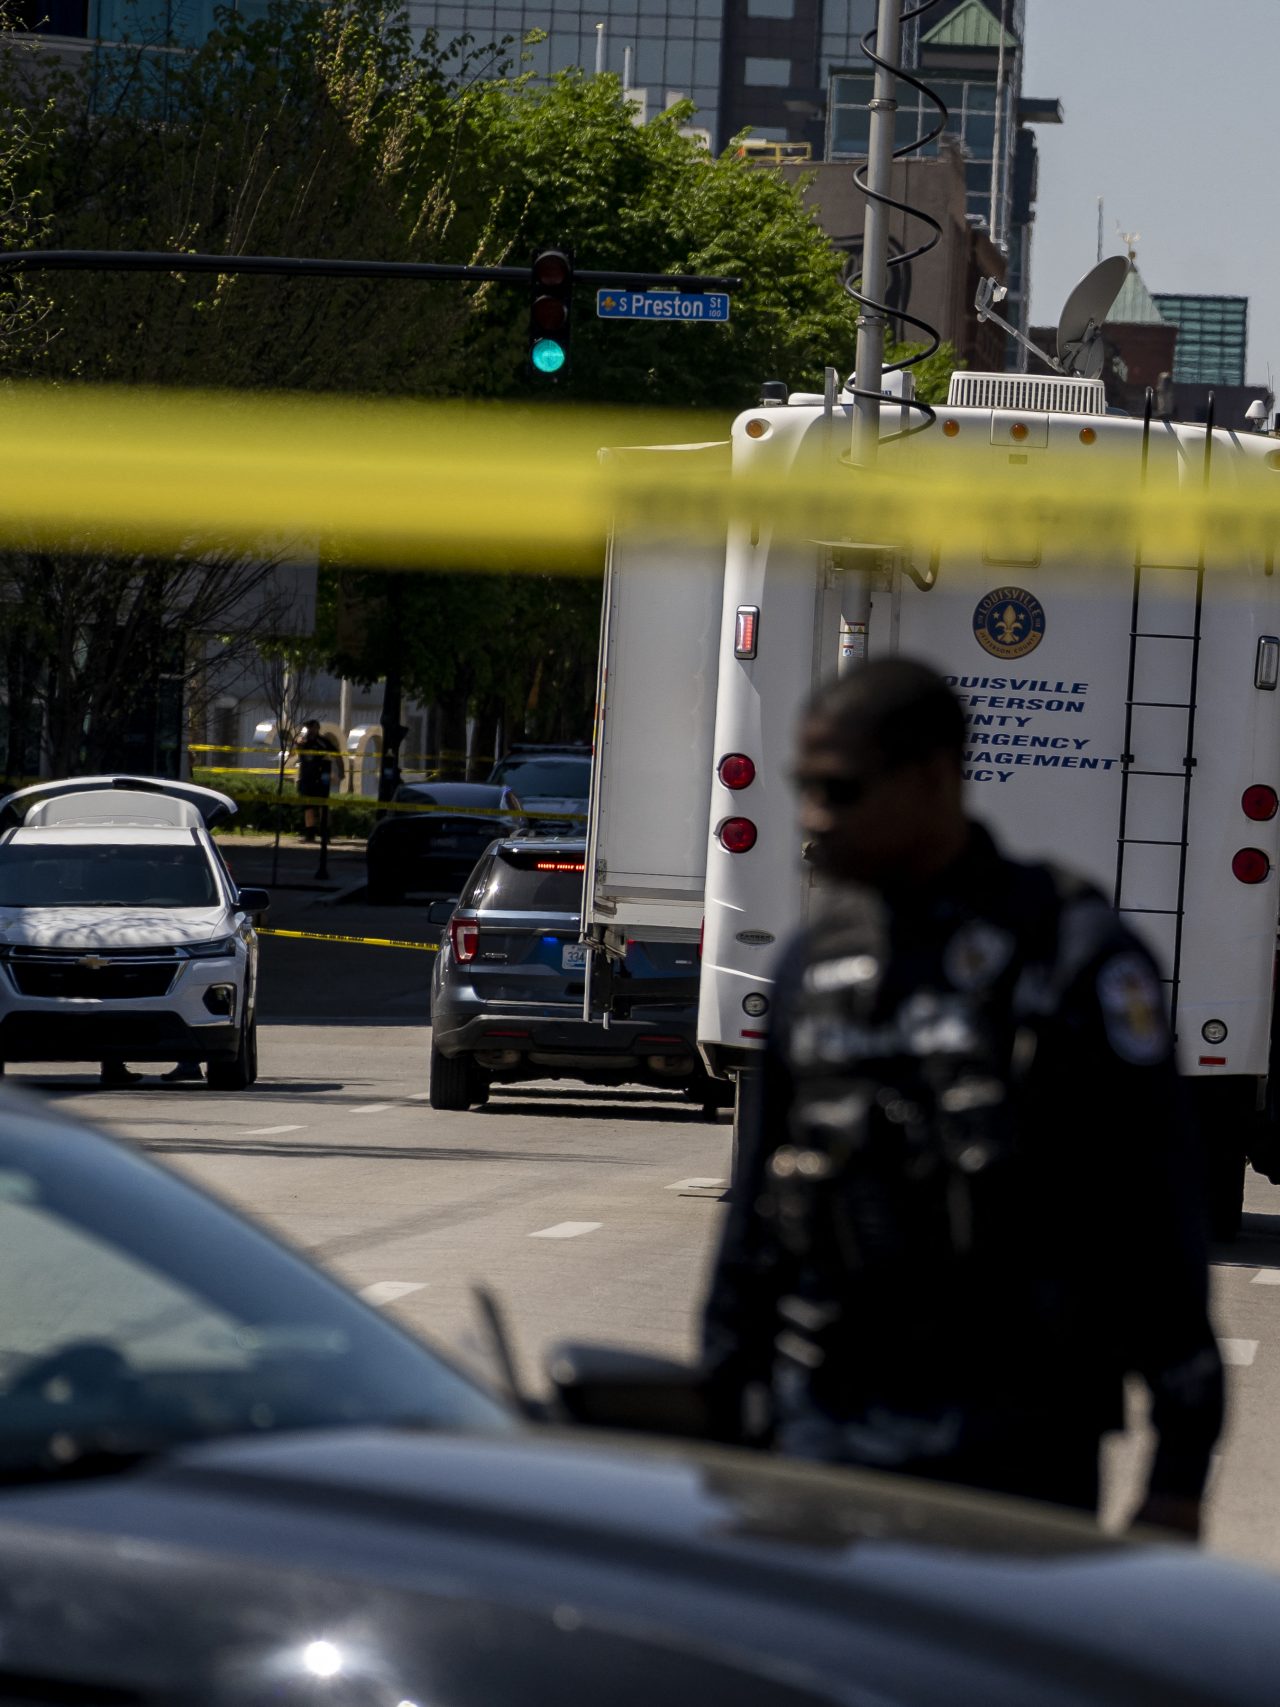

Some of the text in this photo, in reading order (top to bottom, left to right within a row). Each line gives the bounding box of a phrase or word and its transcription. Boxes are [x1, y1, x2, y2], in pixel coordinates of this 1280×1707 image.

[619, 294, 721, 317] S Preston St
[978, 589, 1042, 617] LOUISVILLE
[943, 675, 1089, 695] OUISVILLE
[960, 750, 1119, 770] NAGEMENT
[960, 769, 1015, 783] NCY
